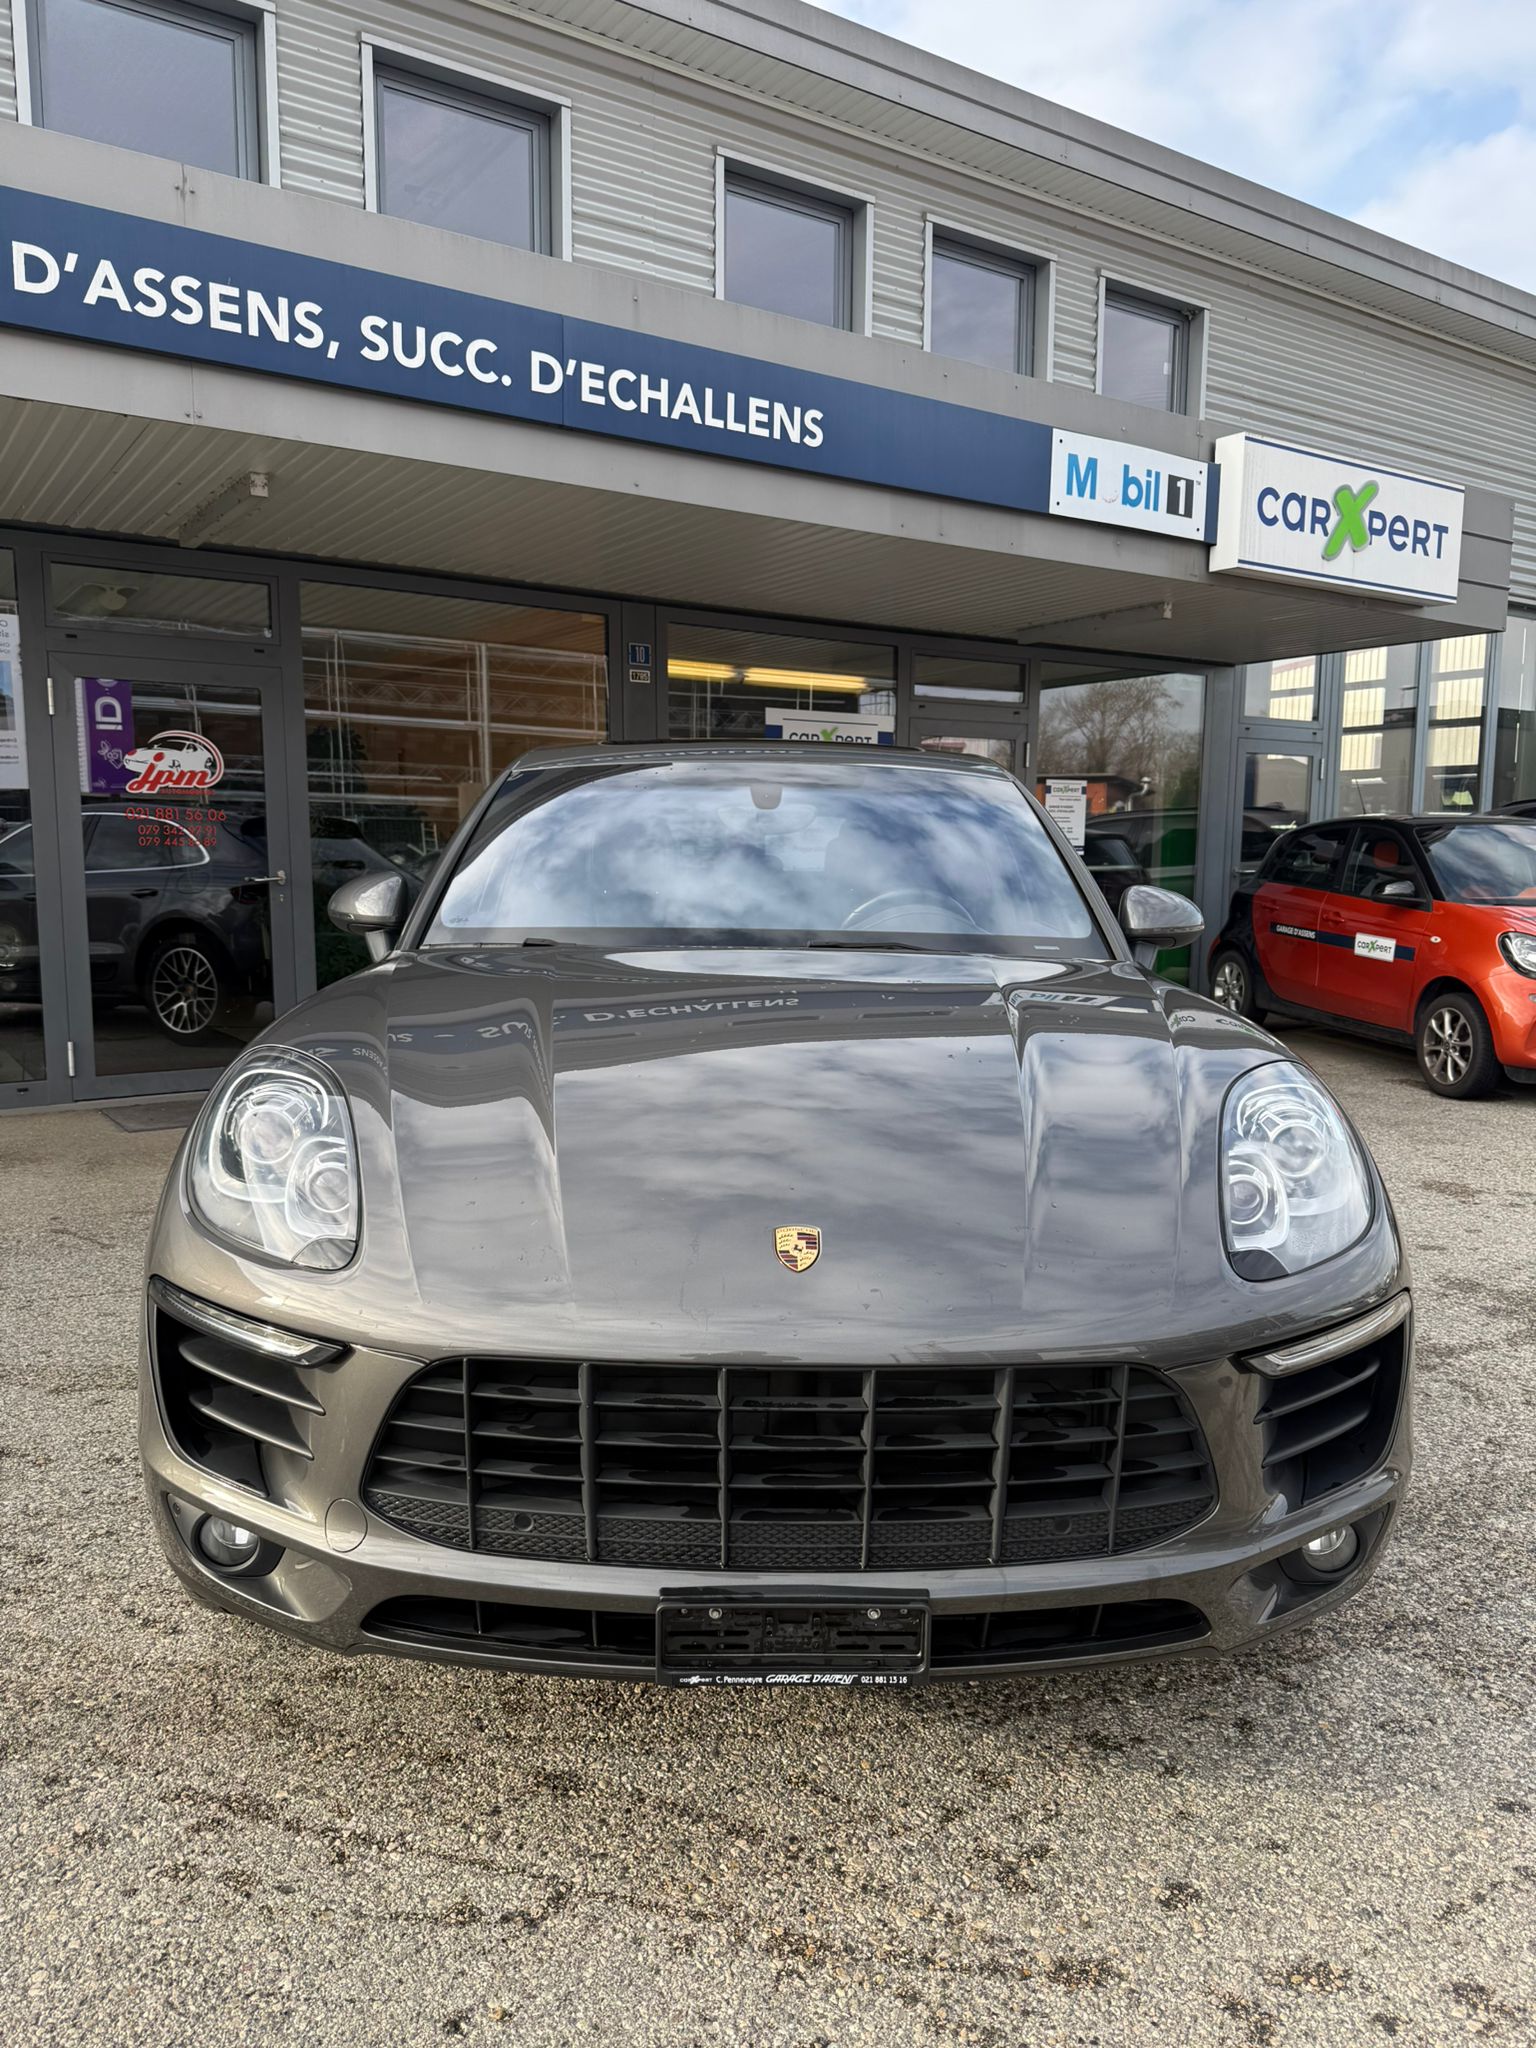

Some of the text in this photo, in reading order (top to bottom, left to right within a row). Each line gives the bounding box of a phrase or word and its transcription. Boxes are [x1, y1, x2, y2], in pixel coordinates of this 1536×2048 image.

[11, 240, 824, 448] D'ASSENS, SUCC. D'ECHALLENS
[1065, 452, 1161, 513] Mbil
[635, 646, 645, 662] 10
[155, 808, 179, 820] 881
[185, 808, 203, 820] 56
[207, 808, 227, 821] 06
[138, 825, 160, 835] 079
[138, 837, 160, 847] 079
[765, 1674, 812, 1684] GARAGE
[861, 1675, 873, 1684] 021
[875, 1675, 887, 1684] 881
[899, 1675, 908, 1684] 16
